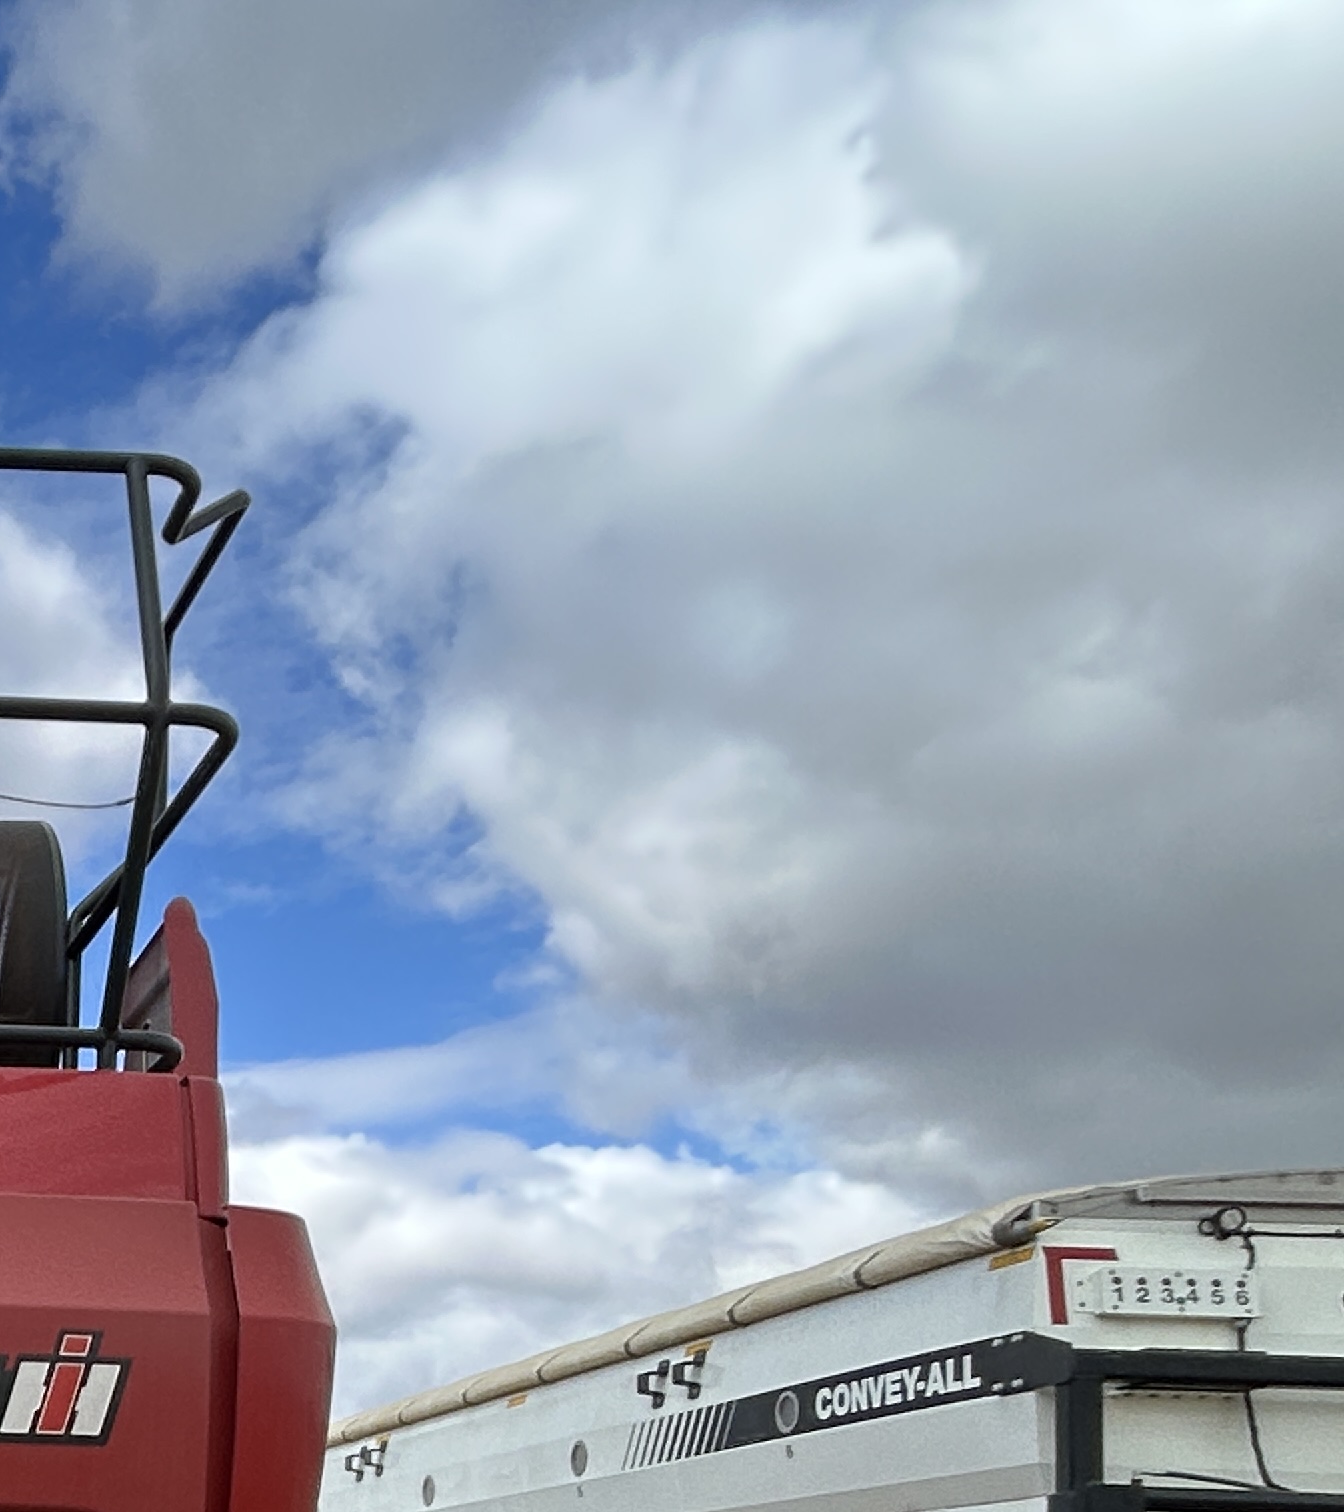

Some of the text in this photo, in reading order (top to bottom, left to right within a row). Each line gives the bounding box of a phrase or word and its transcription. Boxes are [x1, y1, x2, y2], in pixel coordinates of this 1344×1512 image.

[1113, 1286, 1250, 1306] 1 2 3 4 5 6
[814, 1353, 982, 1421] CONVEY-ALL
